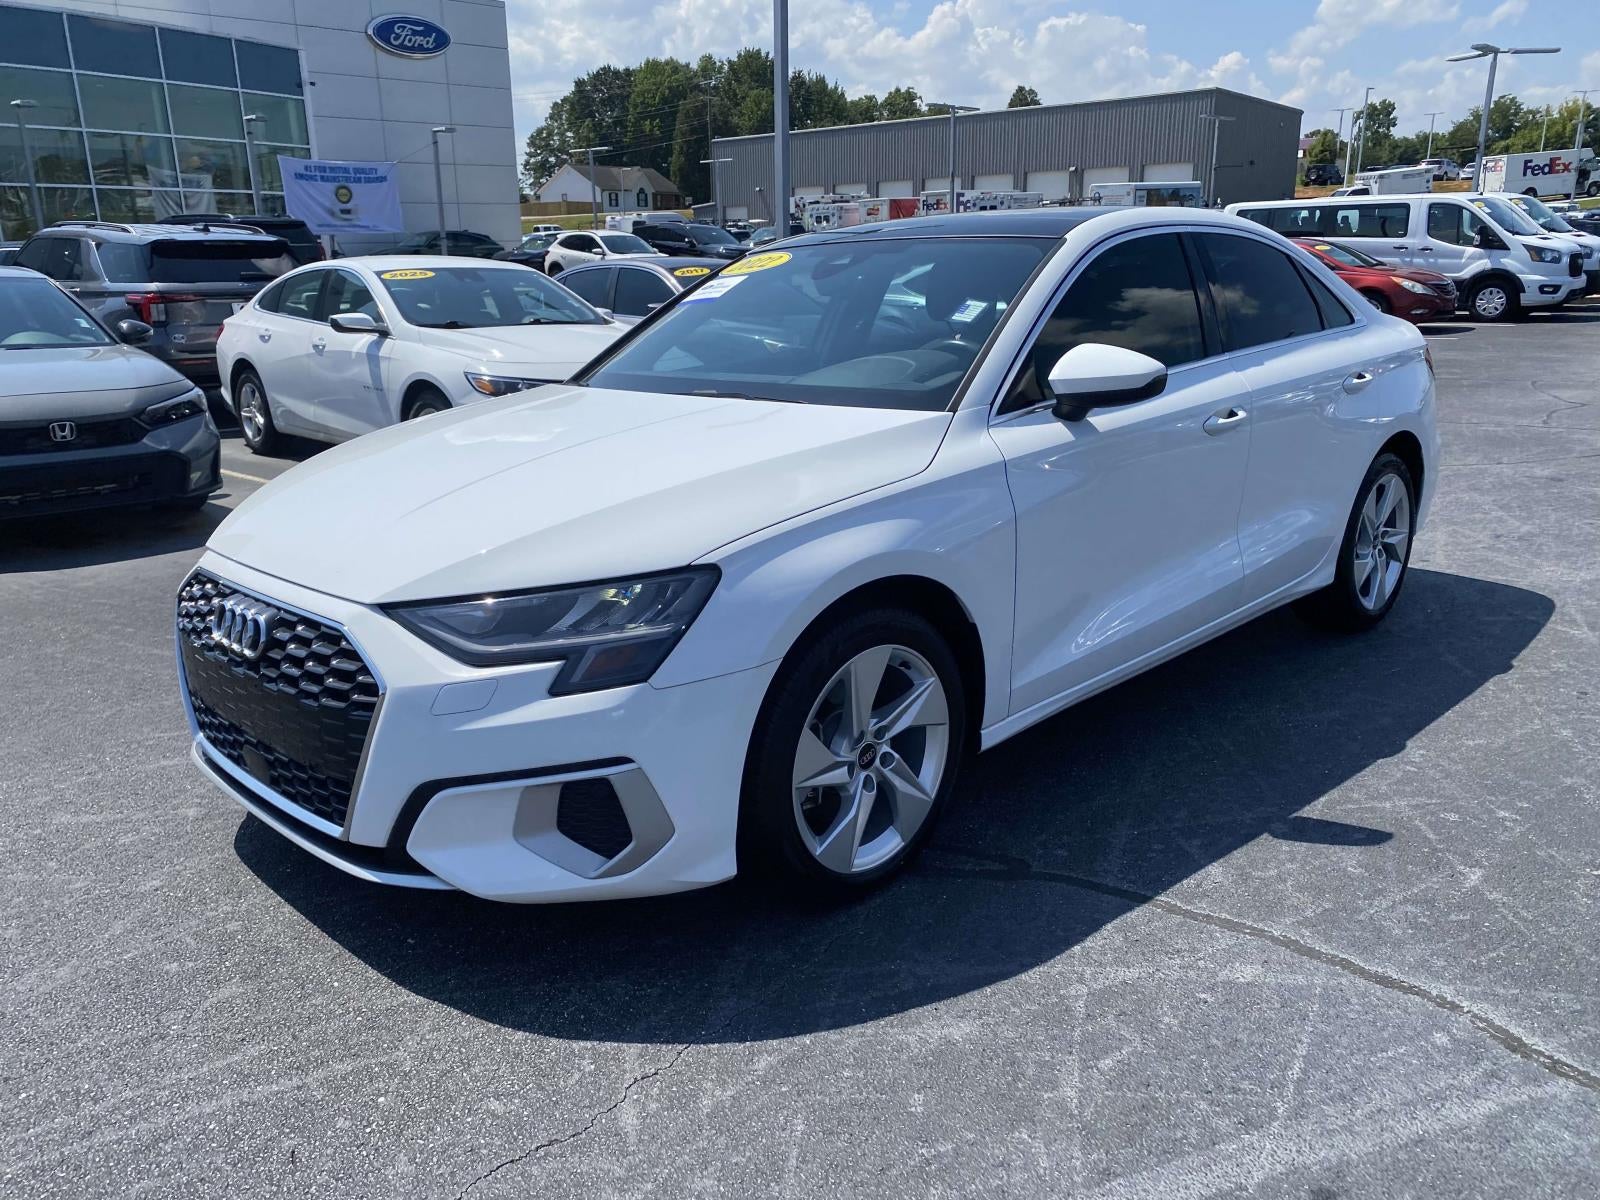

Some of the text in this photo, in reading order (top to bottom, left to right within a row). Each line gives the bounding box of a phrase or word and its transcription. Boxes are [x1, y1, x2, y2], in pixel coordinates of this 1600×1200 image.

[390, 23, 436, 49] Ford
[1522, 156, 1573, 178] FedEx
[922, 198, 949, 211] FedEx
[390, 271, 428, 279] 2025
[679, 267, 704, 276] 2017
